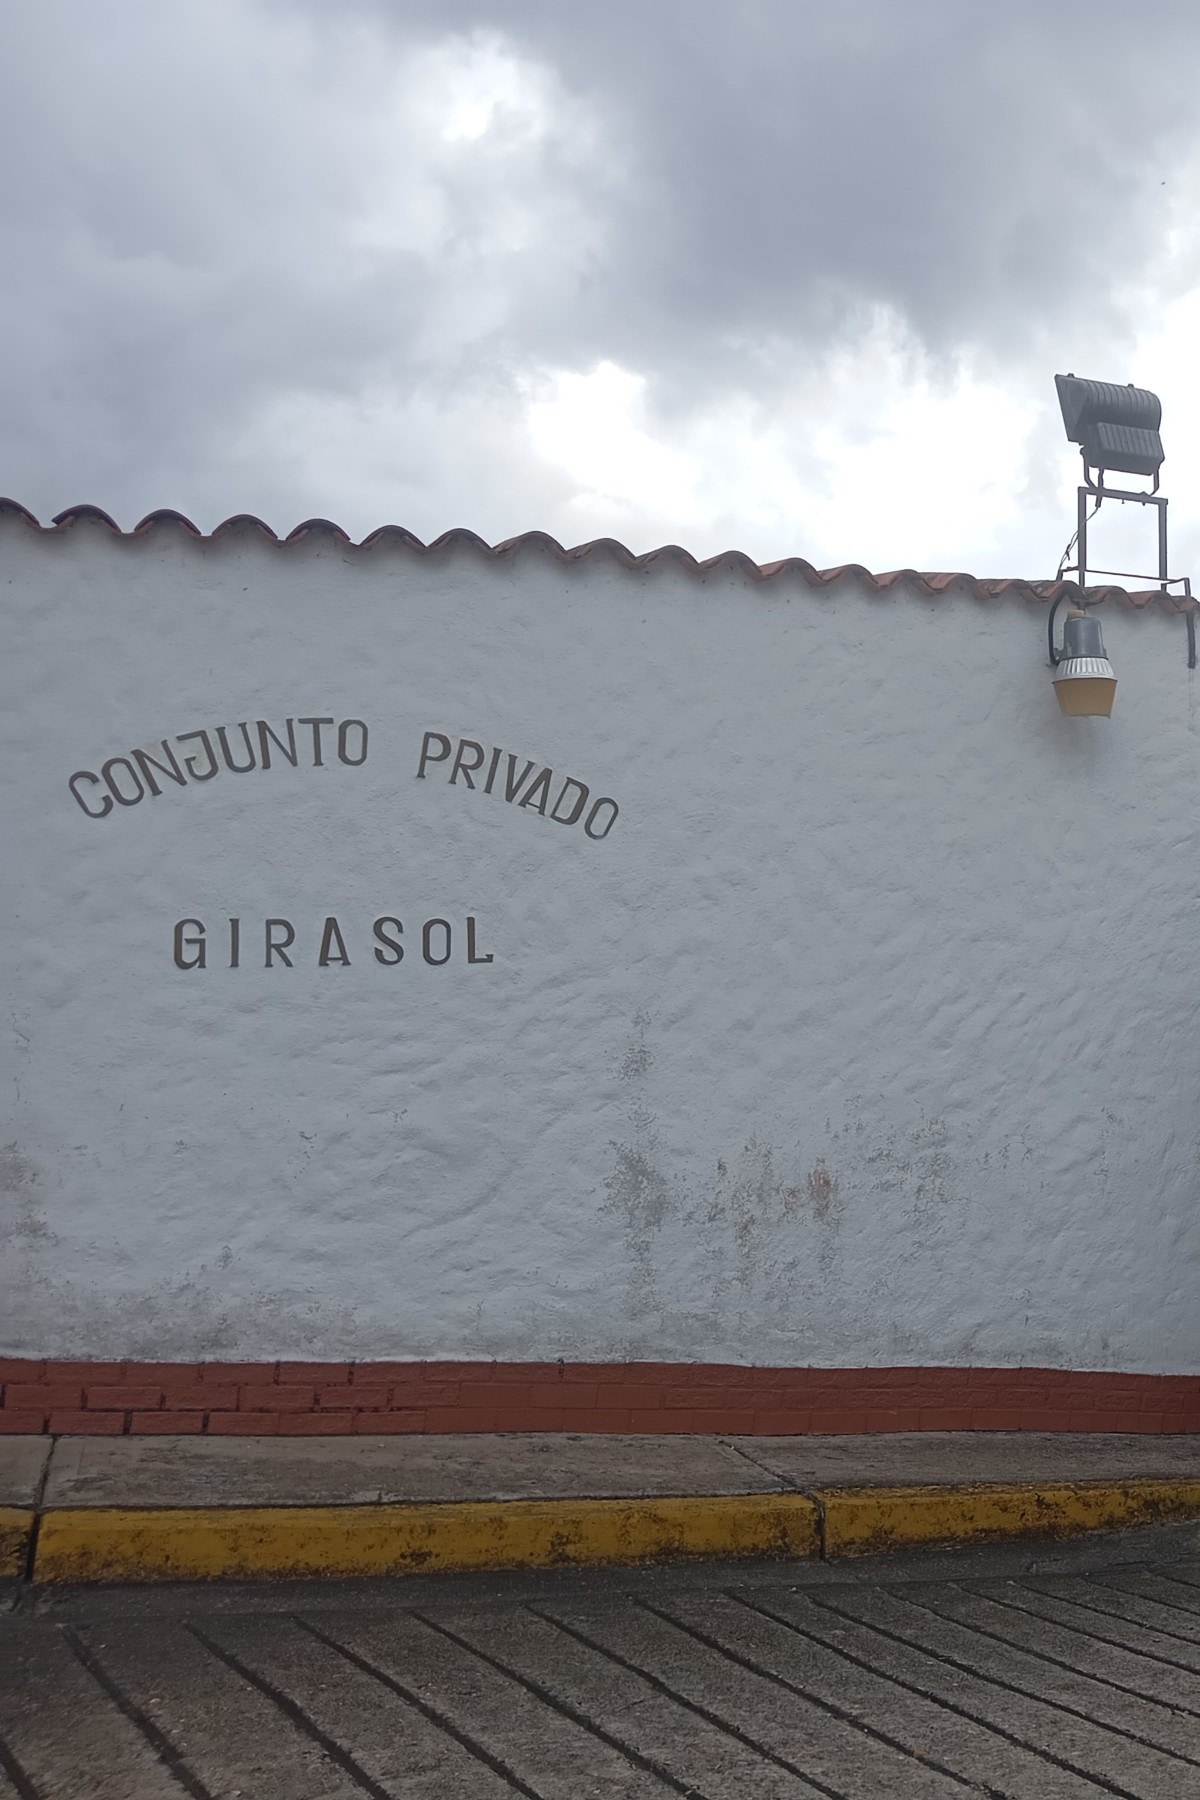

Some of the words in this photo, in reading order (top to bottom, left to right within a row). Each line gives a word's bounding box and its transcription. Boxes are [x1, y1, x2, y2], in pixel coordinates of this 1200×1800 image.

[69, 717, 369, 819] CONJUNTO
[416, 731, 619, 840] PRIVADO
[173, 916, 494, 970] GIRASOL
